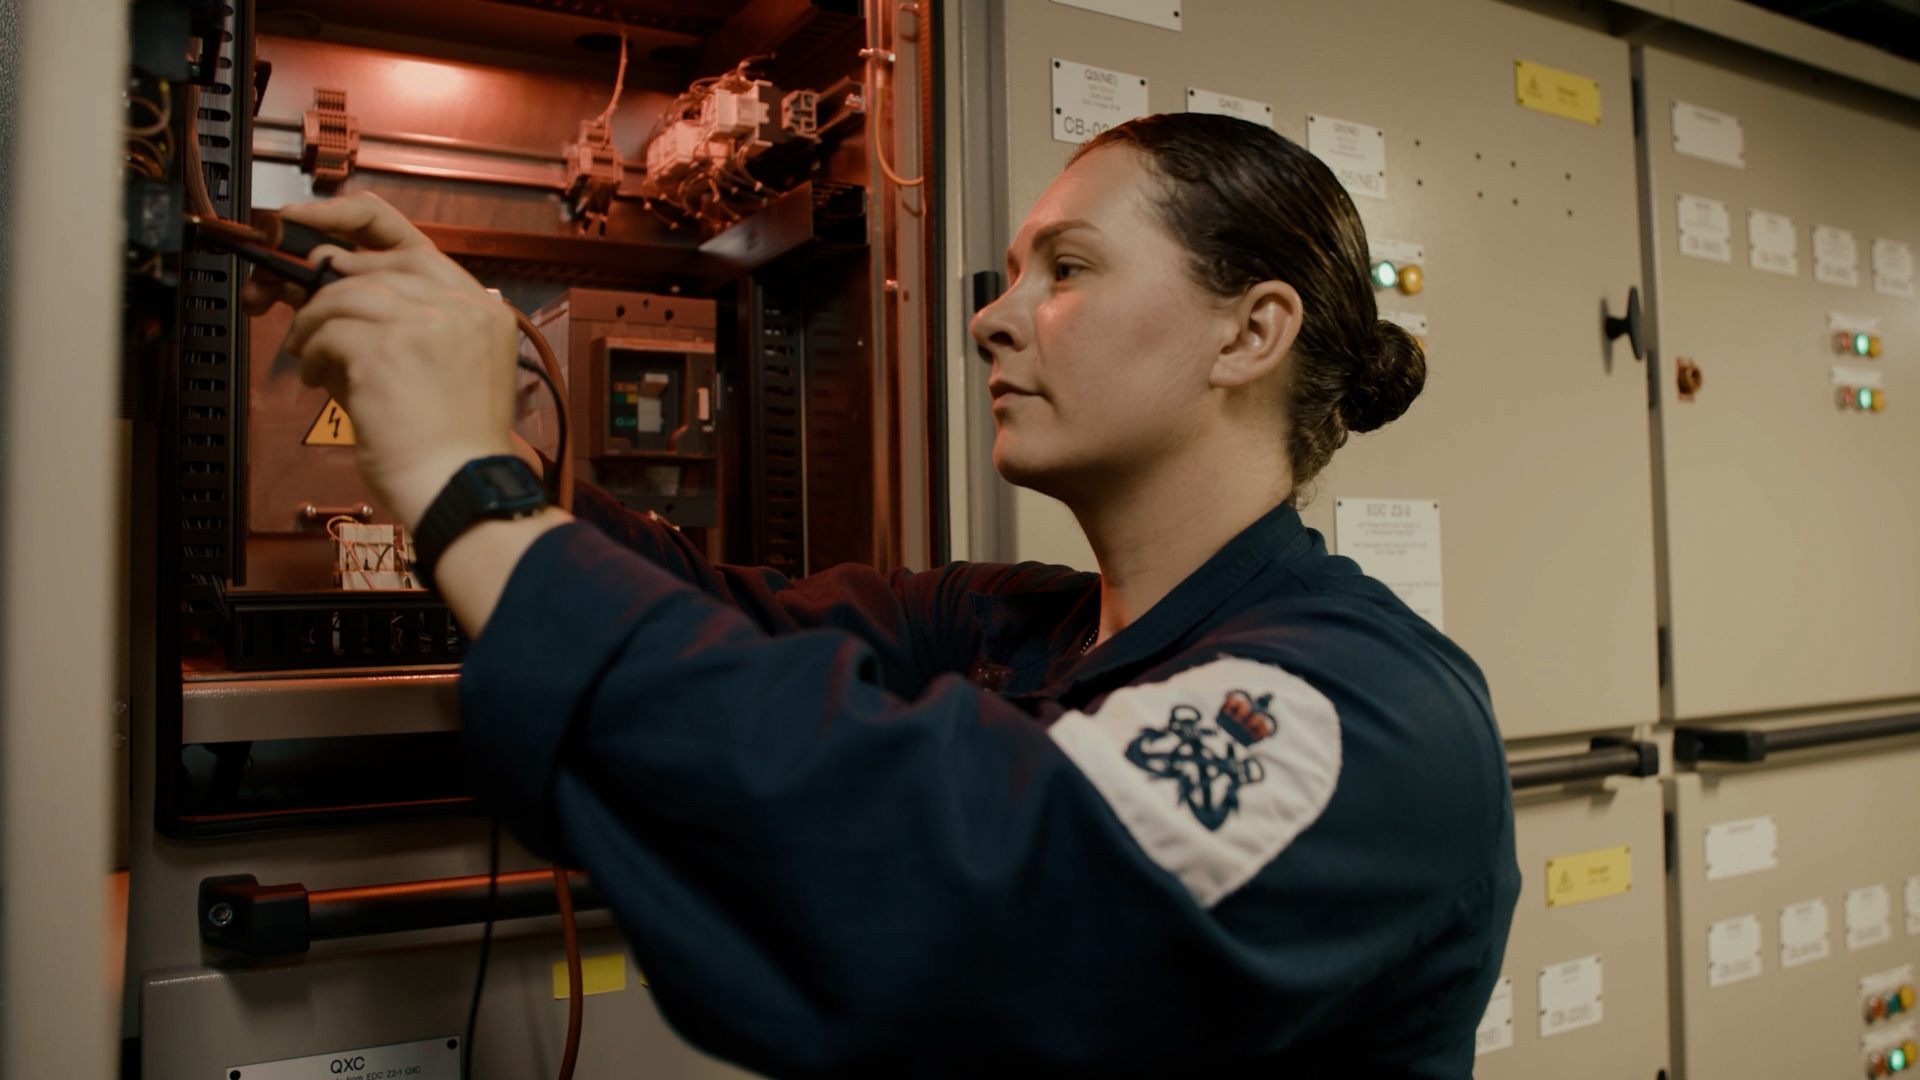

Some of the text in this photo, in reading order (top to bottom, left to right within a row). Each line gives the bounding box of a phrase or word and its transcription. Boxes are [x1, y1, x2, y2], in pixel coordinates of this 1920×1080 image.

[1084, 69, 1118, 87] Q3(NE)
[330, 1056, 366, 1074] QXC
[366, 1071, 384, 1080] EDC
[386, 1069, 403, 1078] Z2-1
[404, 1066, 422, 1075] QXC
